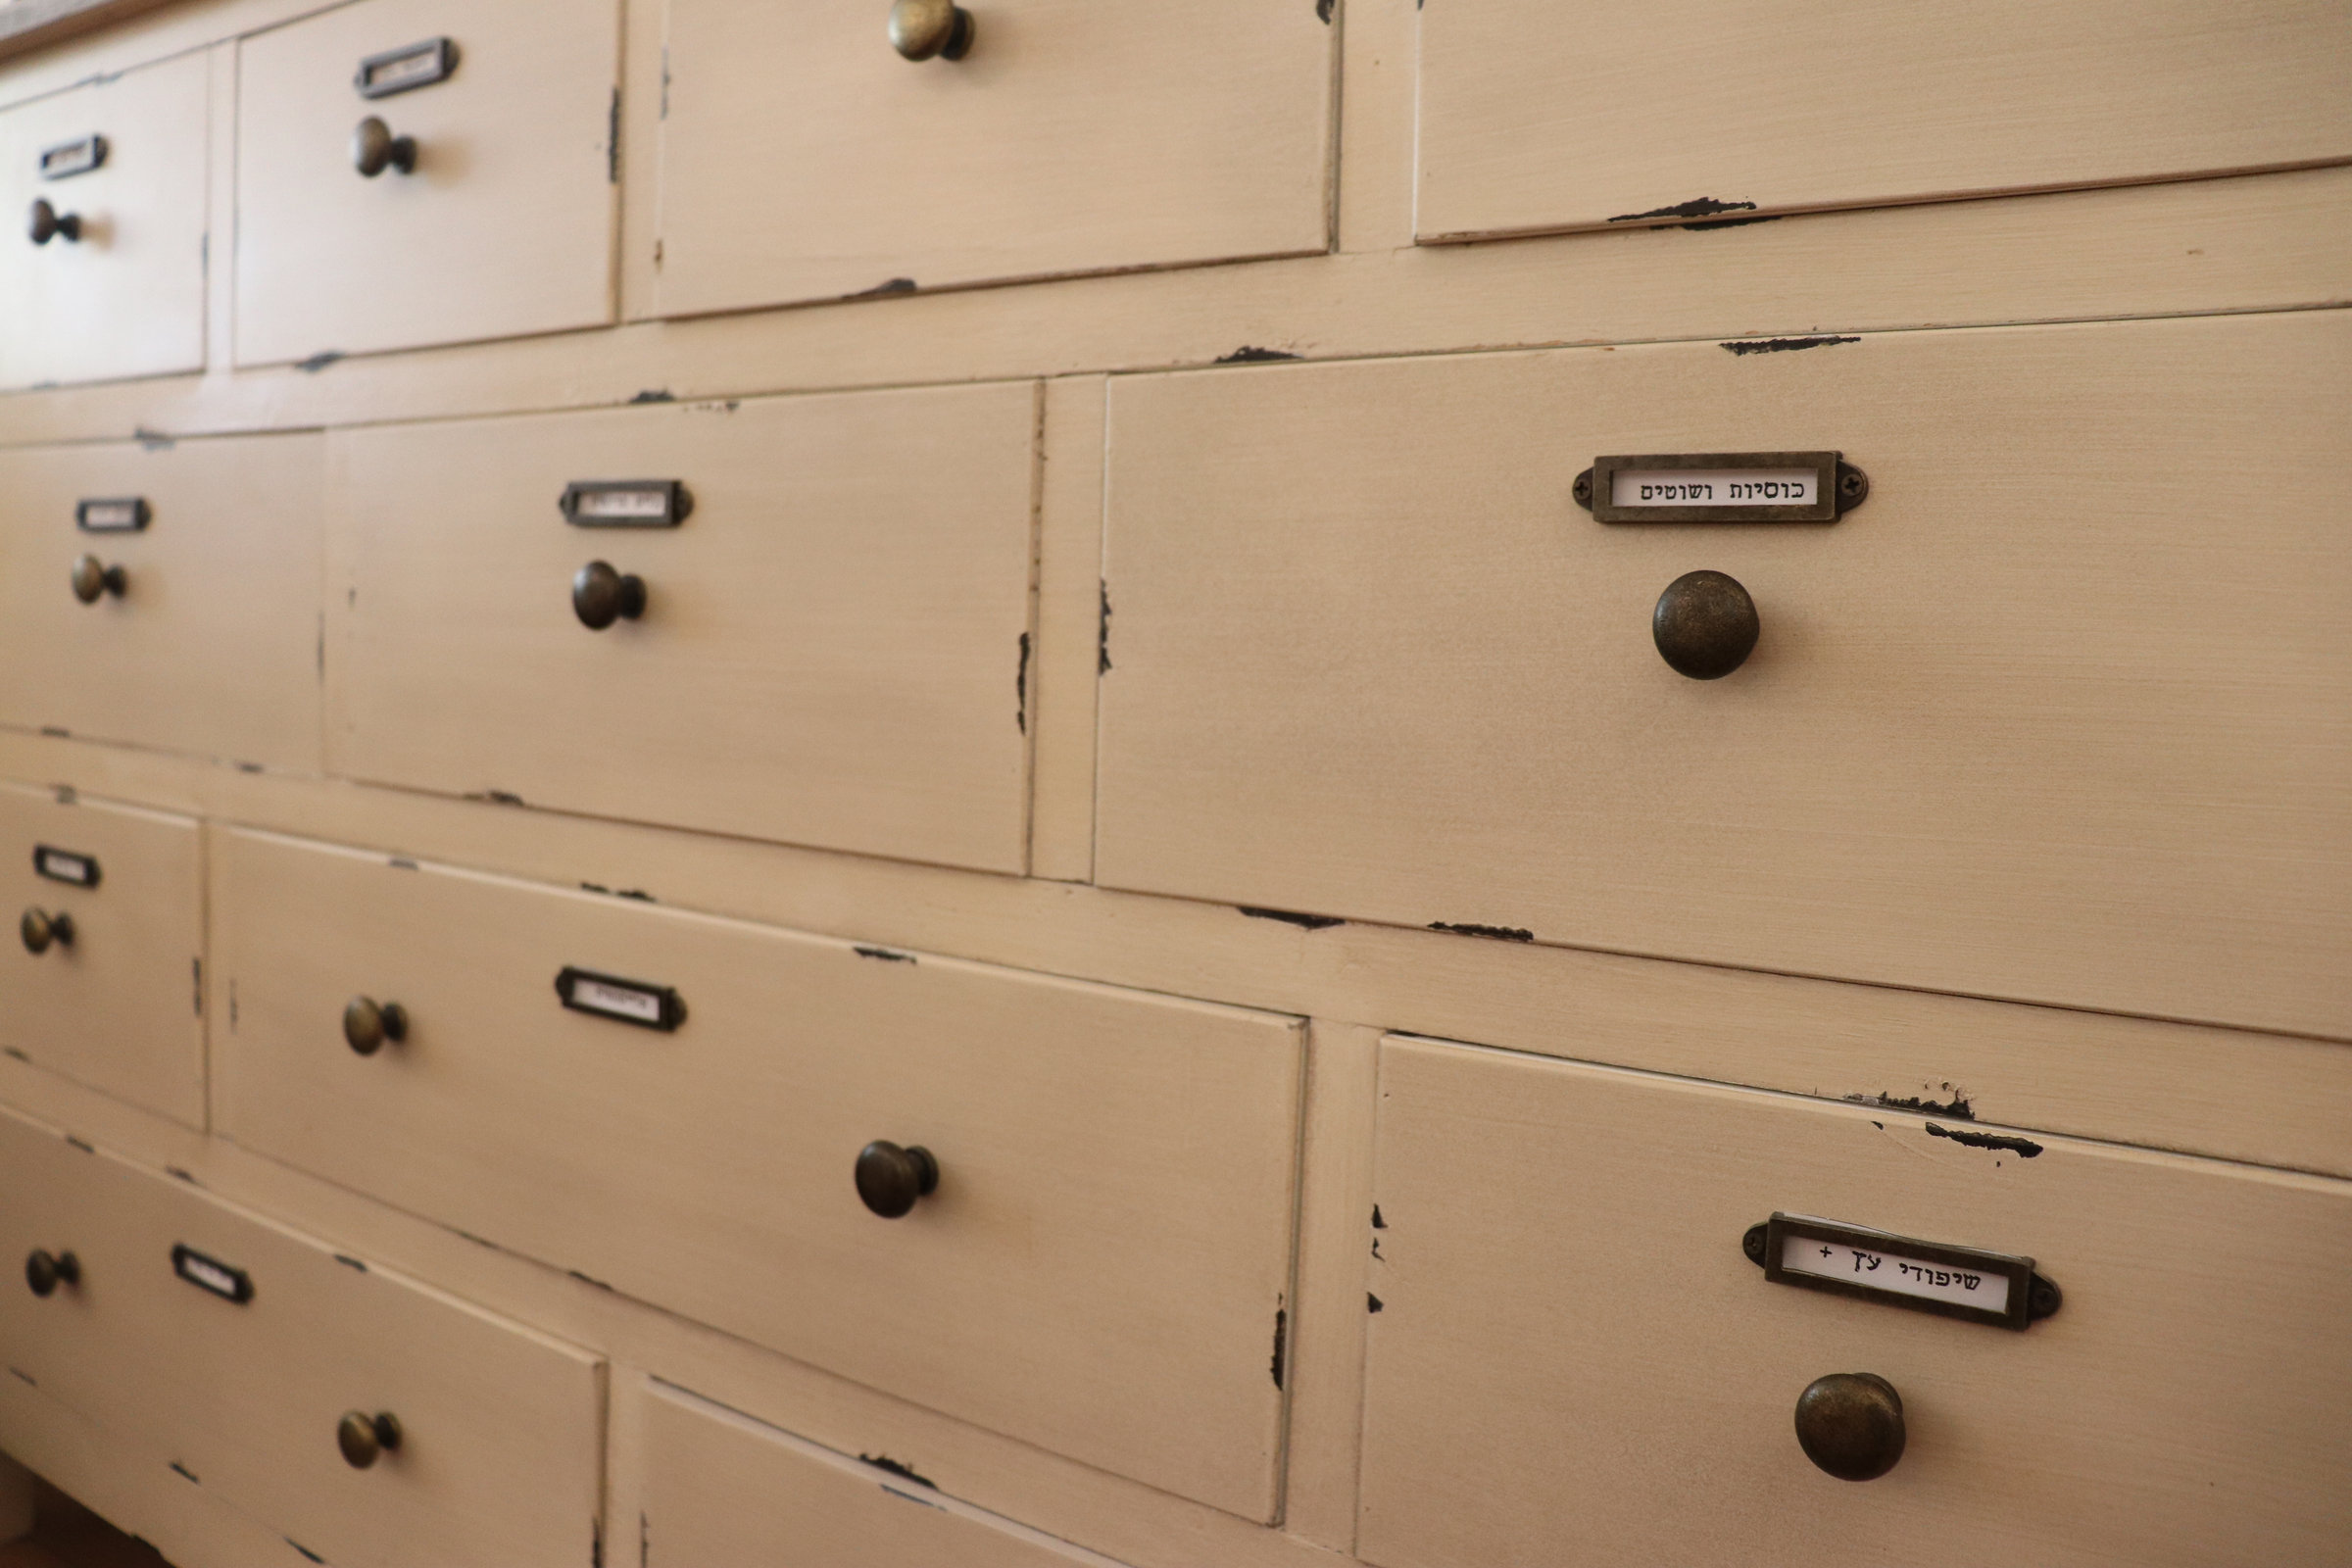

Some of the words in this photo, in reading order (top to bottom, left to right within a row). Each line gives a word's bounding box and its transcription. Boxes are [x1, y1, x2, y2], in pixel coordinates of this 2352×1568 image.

[1640, 484, 1713, 500] ושוטים
[1730, 481, 1805, 499] כוסיות
[1851, 1250, 1882, 1272] עץ
[1898, 1262, 1982, 1291] שיפודי
